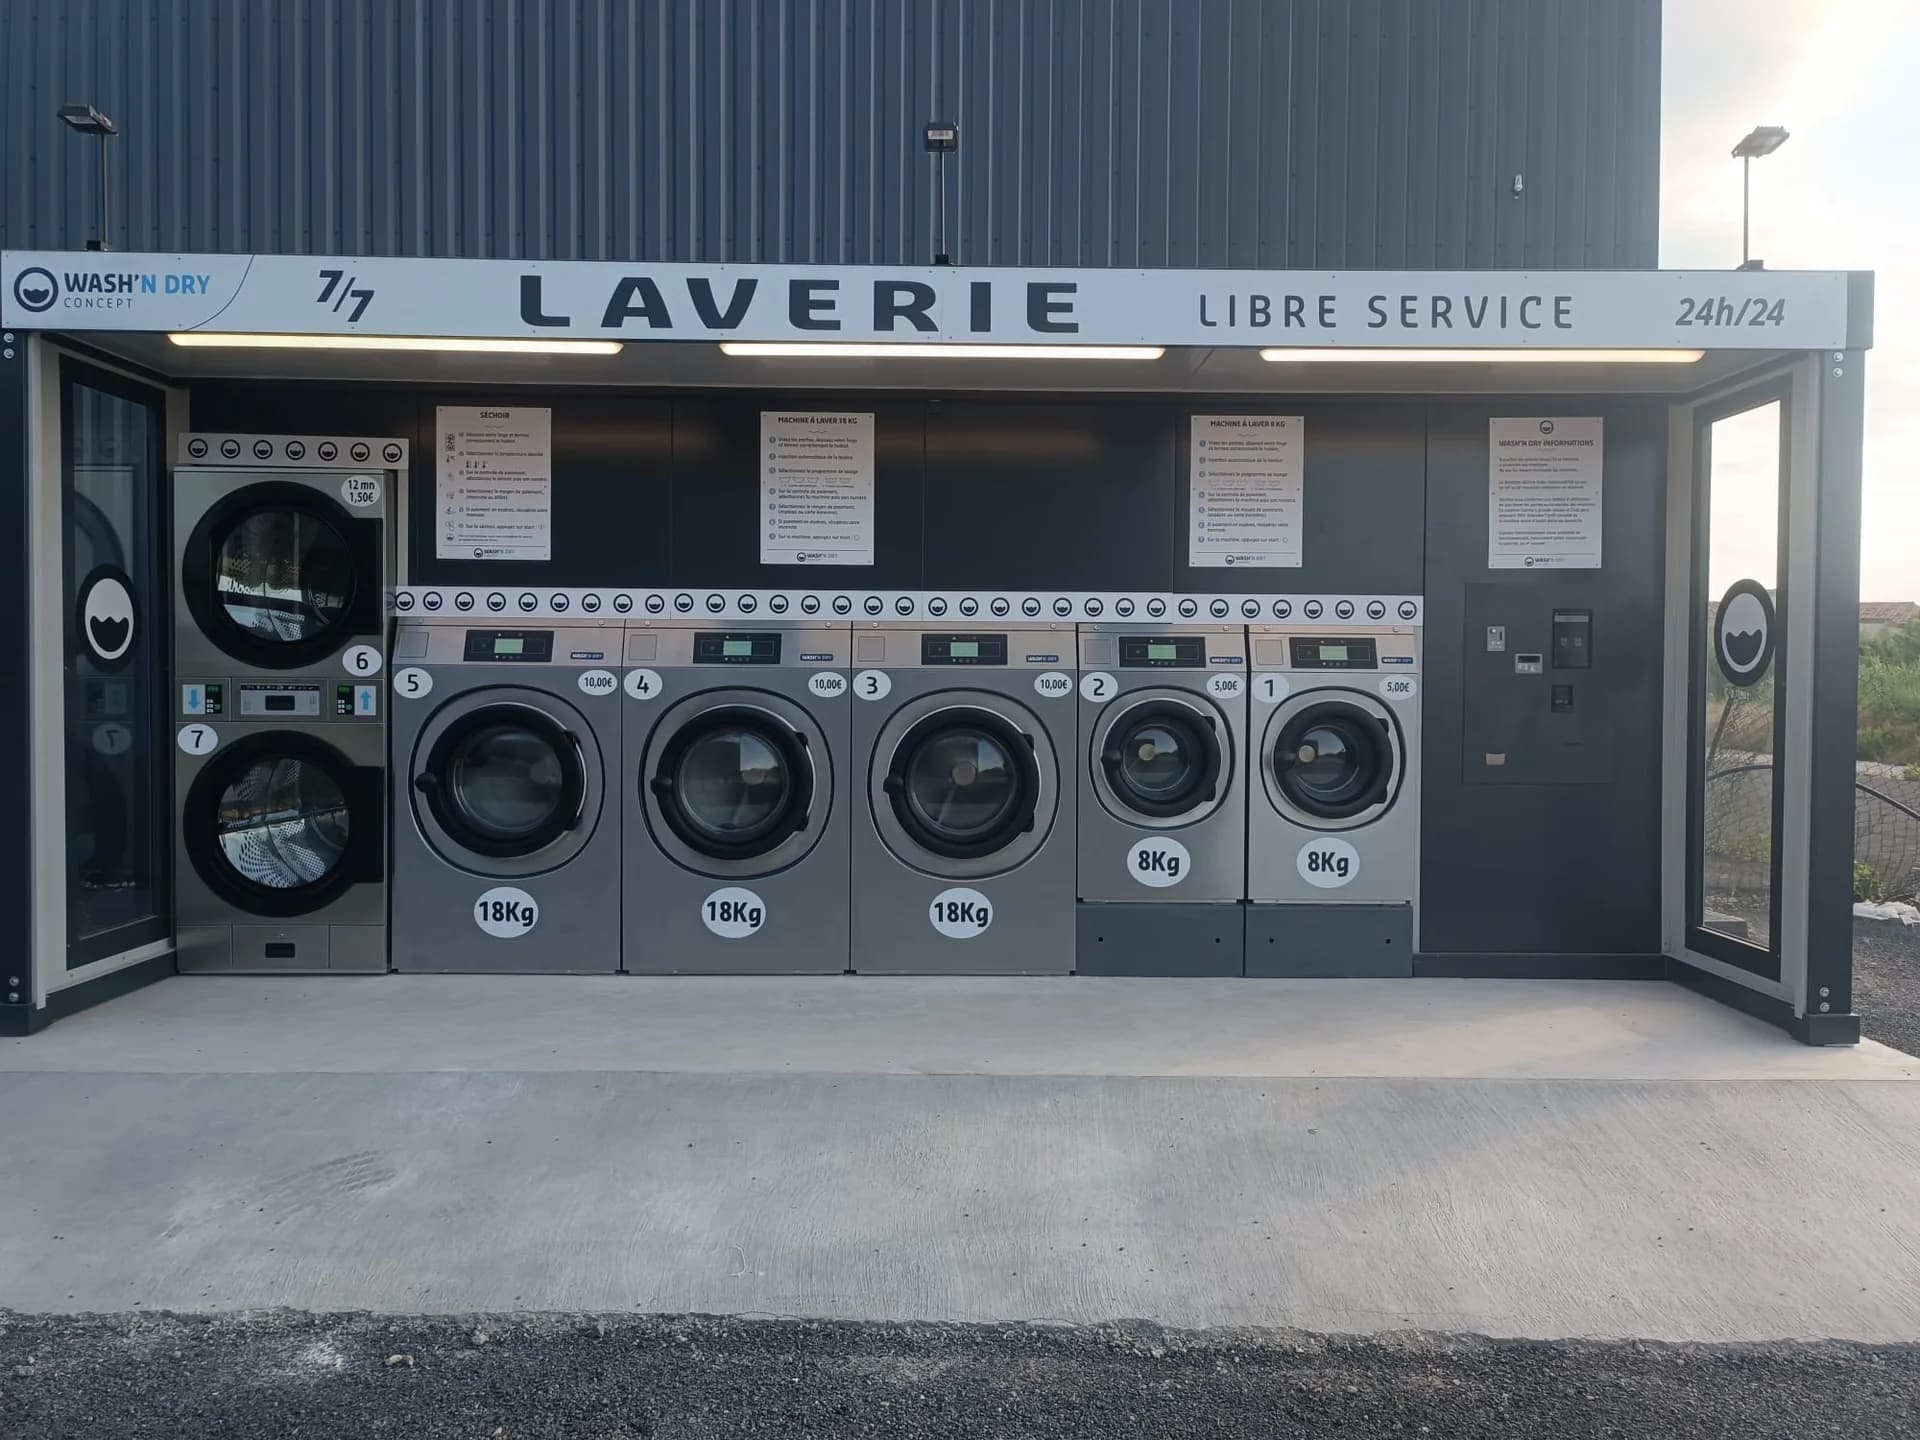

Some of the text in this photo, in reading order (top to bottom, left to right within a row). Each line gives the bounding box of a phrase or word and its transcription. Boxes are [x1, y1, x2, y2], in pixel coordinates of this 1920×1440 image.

[165, 275, 210, 295] DRY
[64, 297, 133, 309] CONCEPT
[316, 270, 375, 322] 7/7
[520, 275, 1079, 334] LAVERIE
[1200, 293, 1574, 329] LIBRE SERVICE
[1675, 297, 1786, 327] 24h/24
[480, 410, 510, 419] SÉCHOIR
[778, 416, 808, 424] MACHINE
[816, 417, 838, 425] LAVER
[1210, 420, 1241, 428] MACHINE
[348, 480, 375, 490] 12 mn
[349, 492, 374, 503] 1,50€
[356, 652, 369, 670] 6
[407, 674, 419, 692] 5
[584, 677, 612, 688] 10,00€
[637, 675, 649, 693] 4
[814, 679, 842, 690] 10,00€
[866, 676, 878, 694] 3
[1040, 679, 1068, 690] 10,00€
[1093, 678, 1104, 696] 2
[1215, 680, 1238, 693] 5,00€
[1264, 679, 1273, 697] 1
[1387, 681, 1410, 694] 5,00€
[191, 730, 204, 748] 7
[1138, 850, 1180, 877] 8Kg
[1307, 851, 1349, 878] 8Kg
[478, 900, 535, 928] 18Kg
[706, 900, 762, 928] 18Kg
[933, 901, 989, 929] 18Kg
